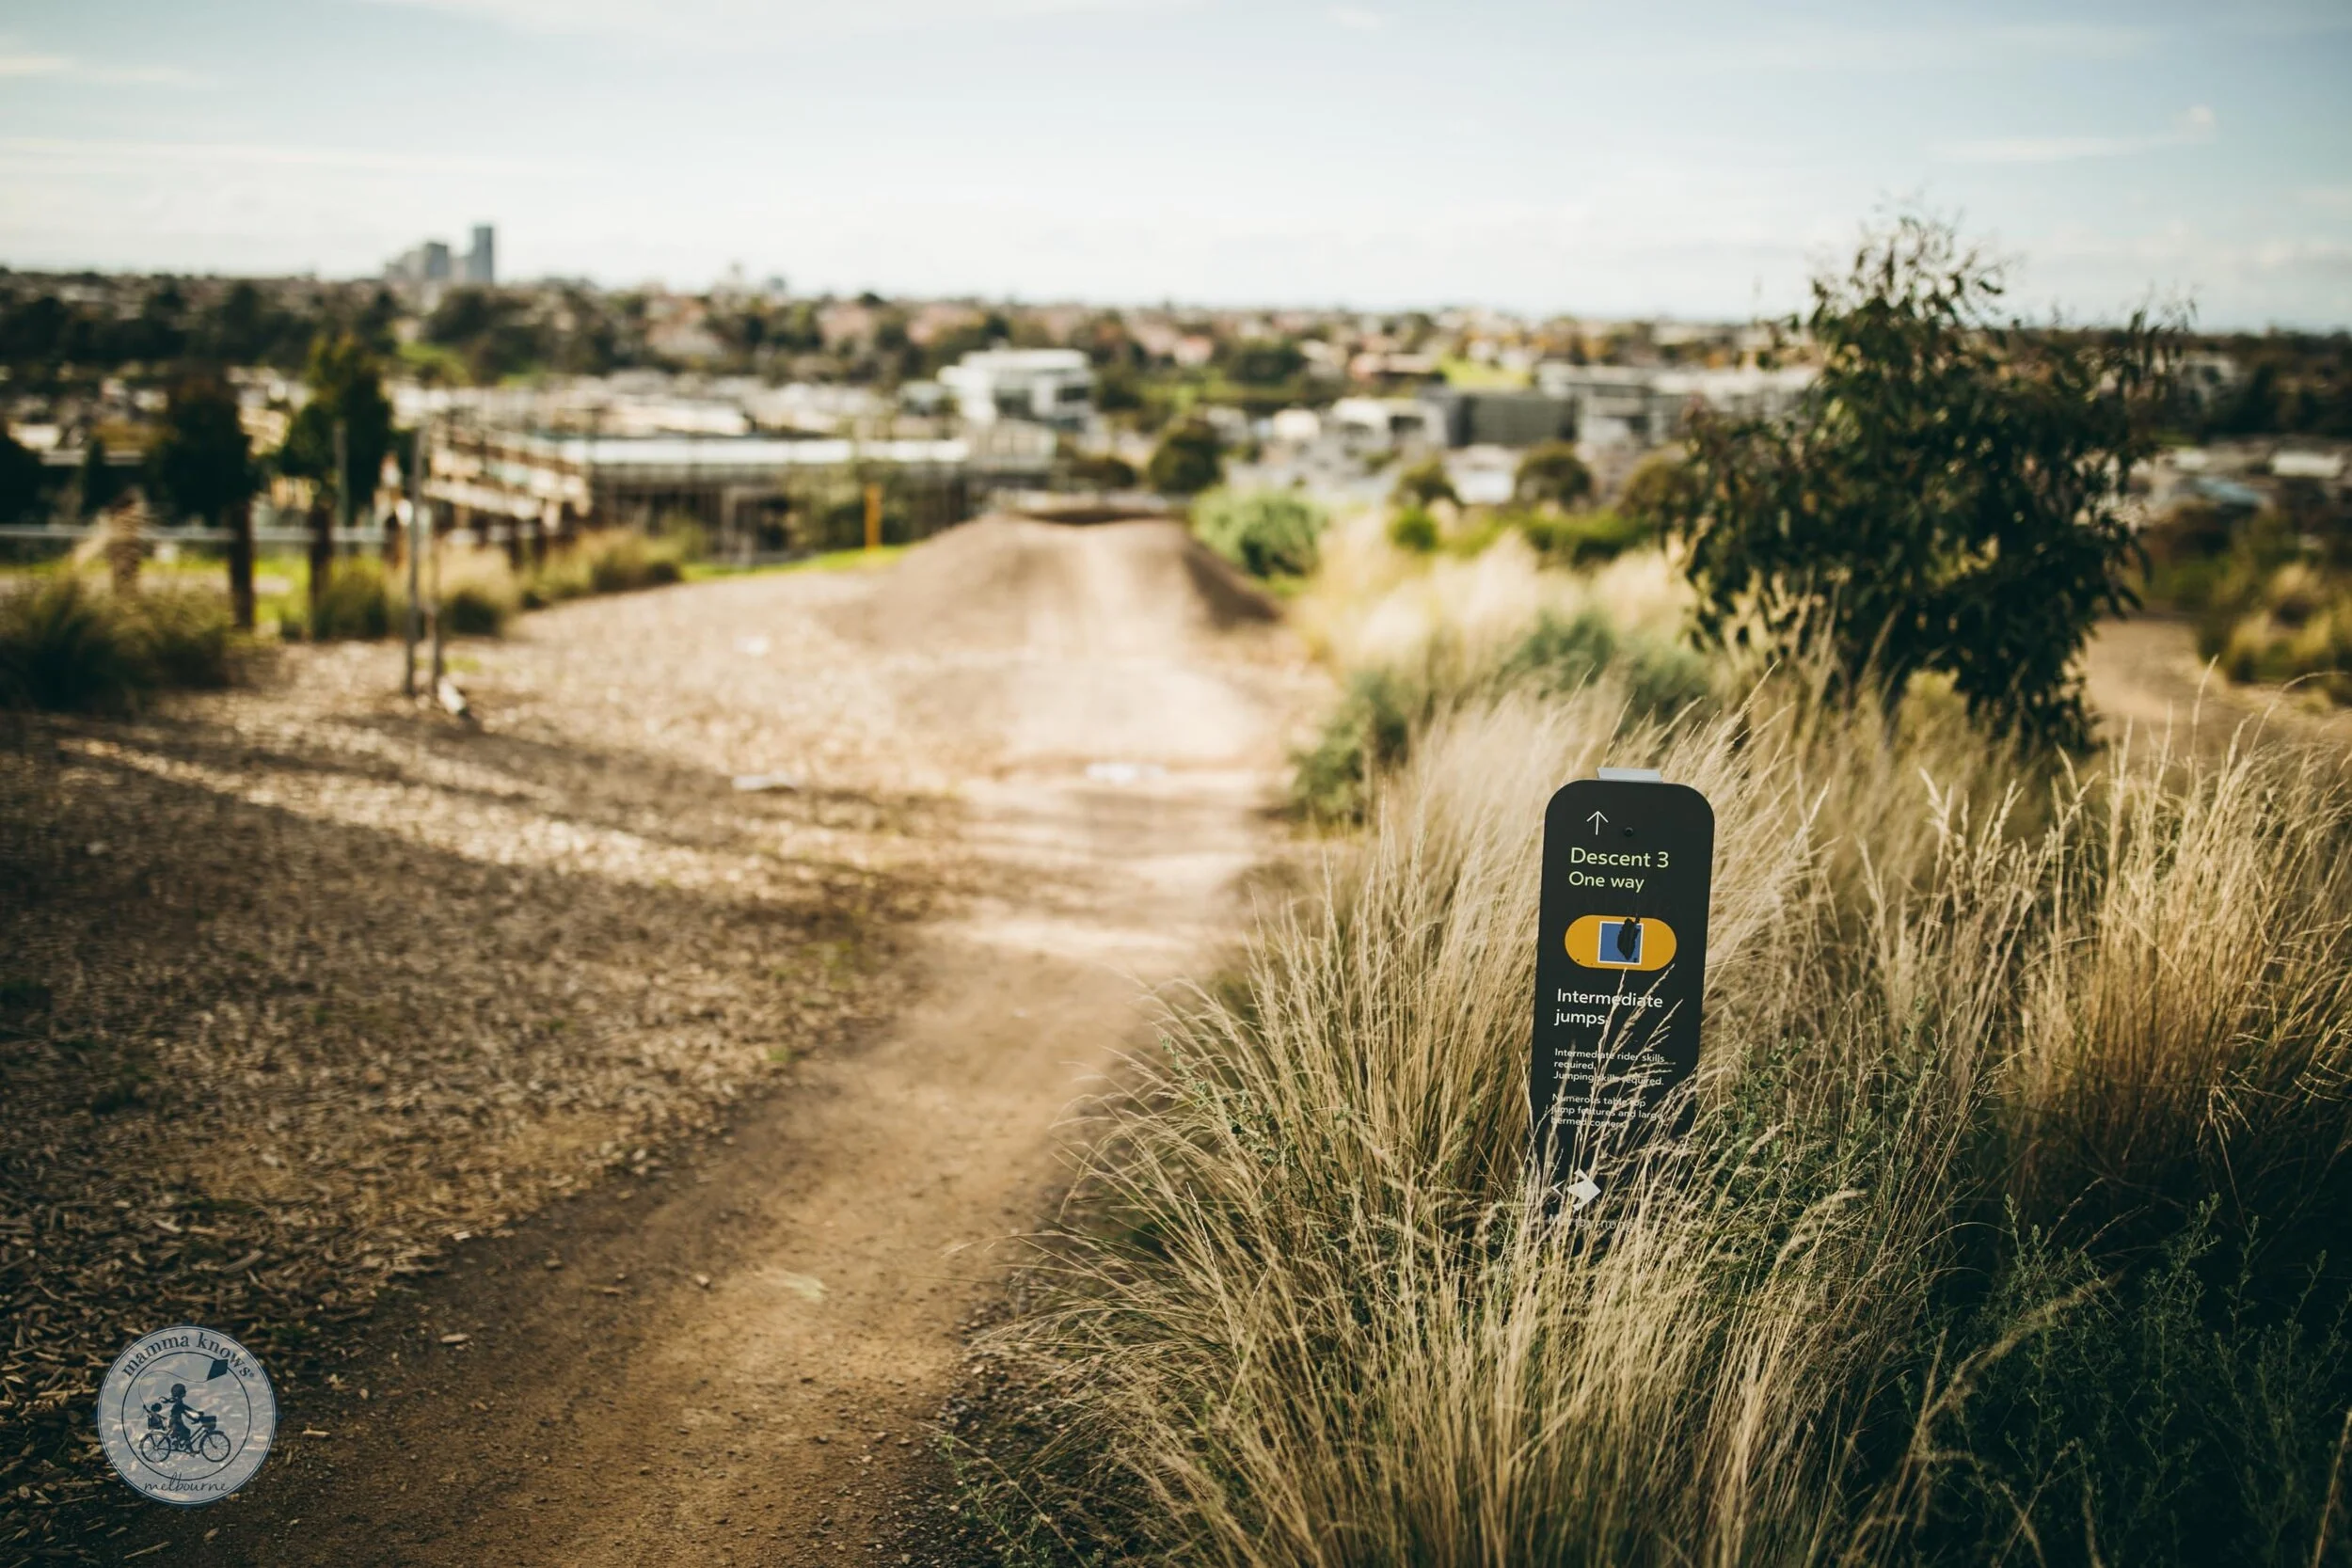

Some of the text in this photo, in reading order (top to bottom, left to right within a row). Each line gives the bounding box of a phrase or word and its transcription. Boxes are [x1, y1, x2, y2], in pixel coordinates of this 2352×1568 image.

[1570, 847, 1669, 868] Descent 3
[1568, 871, 1645, 893] One way
[1557, 988, 1663, 1007] Intermediate
[1553, 1008, 1606, 1028] jumps
[1554, 1047, 1665, 1063] Intermedat rider skills
[1553, 1070, 1664, 1086] Jumping kill equired.
[1552, 1093, 1601, 1104] Nmeros
[1630, 1099, 1646, 1109] op
